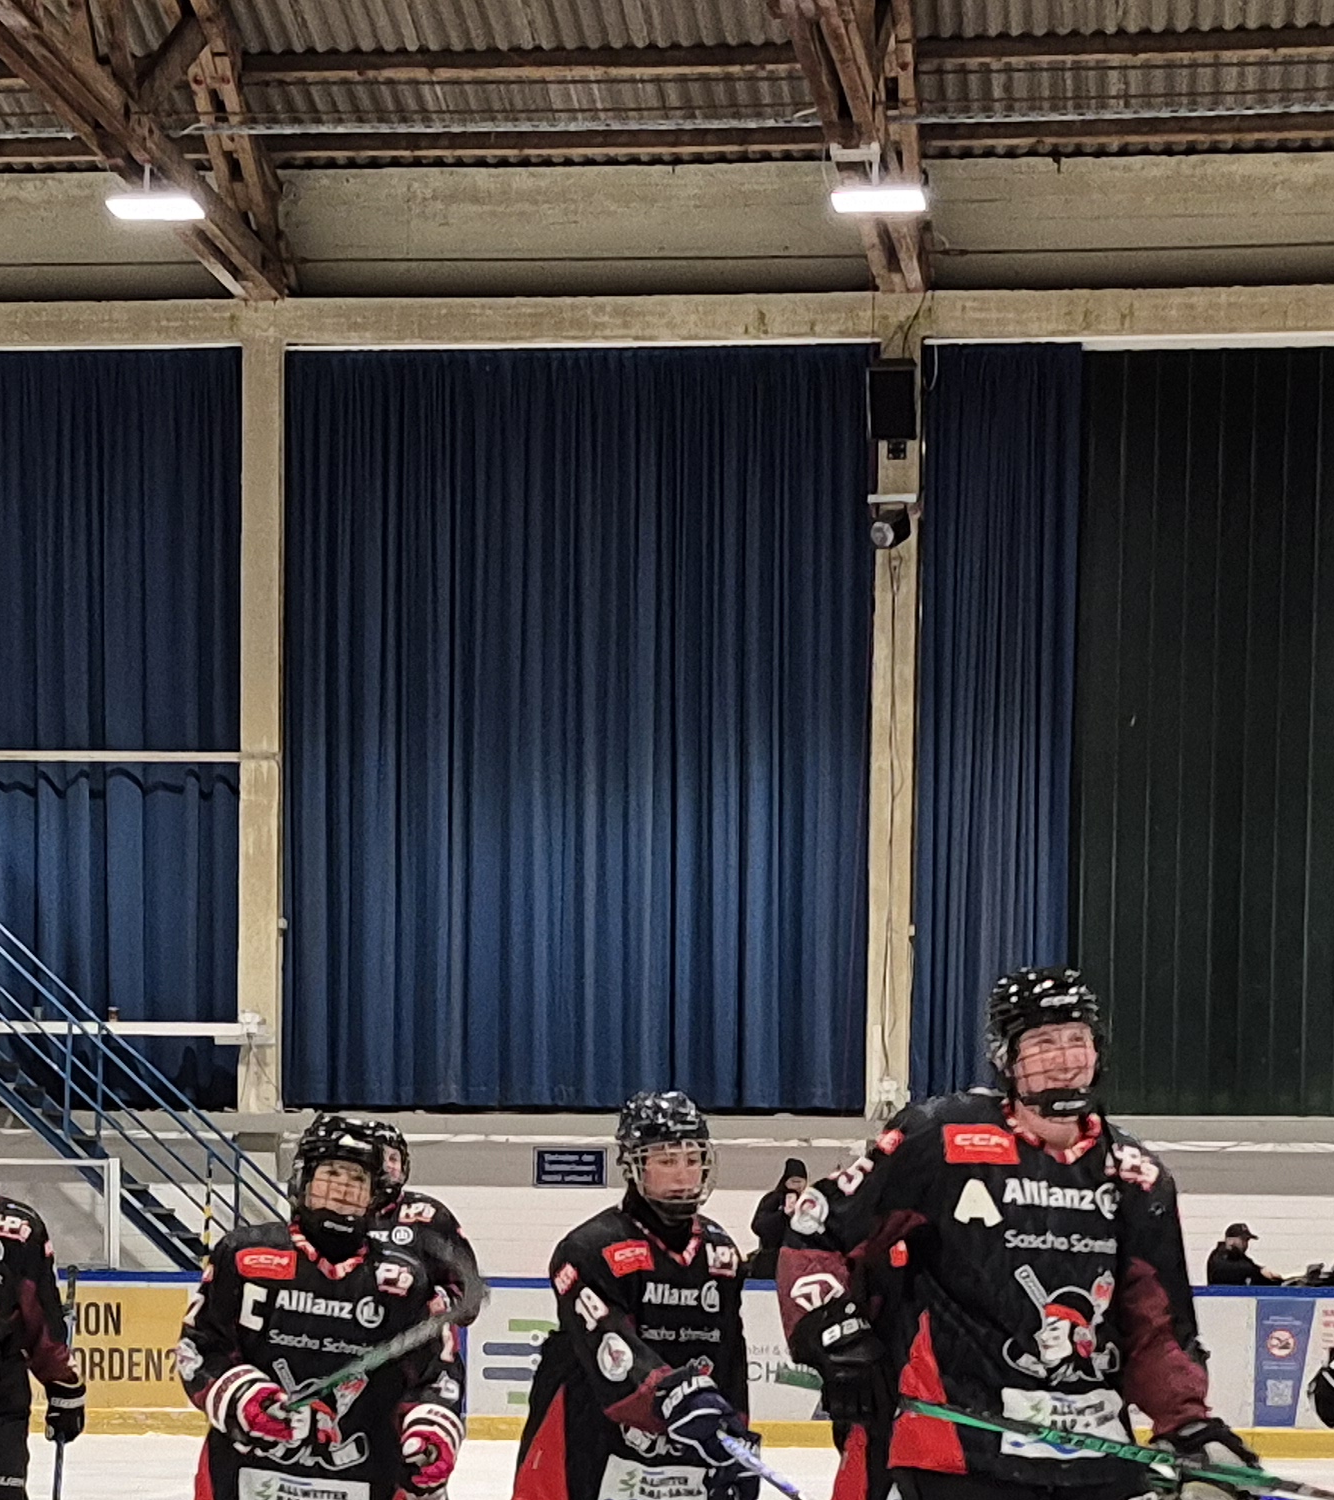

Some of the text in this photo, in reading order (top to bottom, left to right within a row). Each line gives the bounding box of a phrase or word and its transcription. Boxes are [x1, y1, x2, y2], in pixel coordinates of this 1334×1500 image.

[954, 1134, 1010, 1147] CCM
[954, 1178, 1003, 1227] A
[1002, 1178, 1096, 1210] Allianz
[1004, 1229, 1067, 1250] Sascha
[243, 1255, 290, 1266] CCM
[275, 1290, 354, 1319] Allianz
[642, 1282, 700, 1306] Allianz
[239, 1282, 267, 1331] C
[75, 1302, 121, 1336] ION
[269, 1329, 320, 1350] Sascha
[278, 1484, 347, 1500] ALLWETTER
